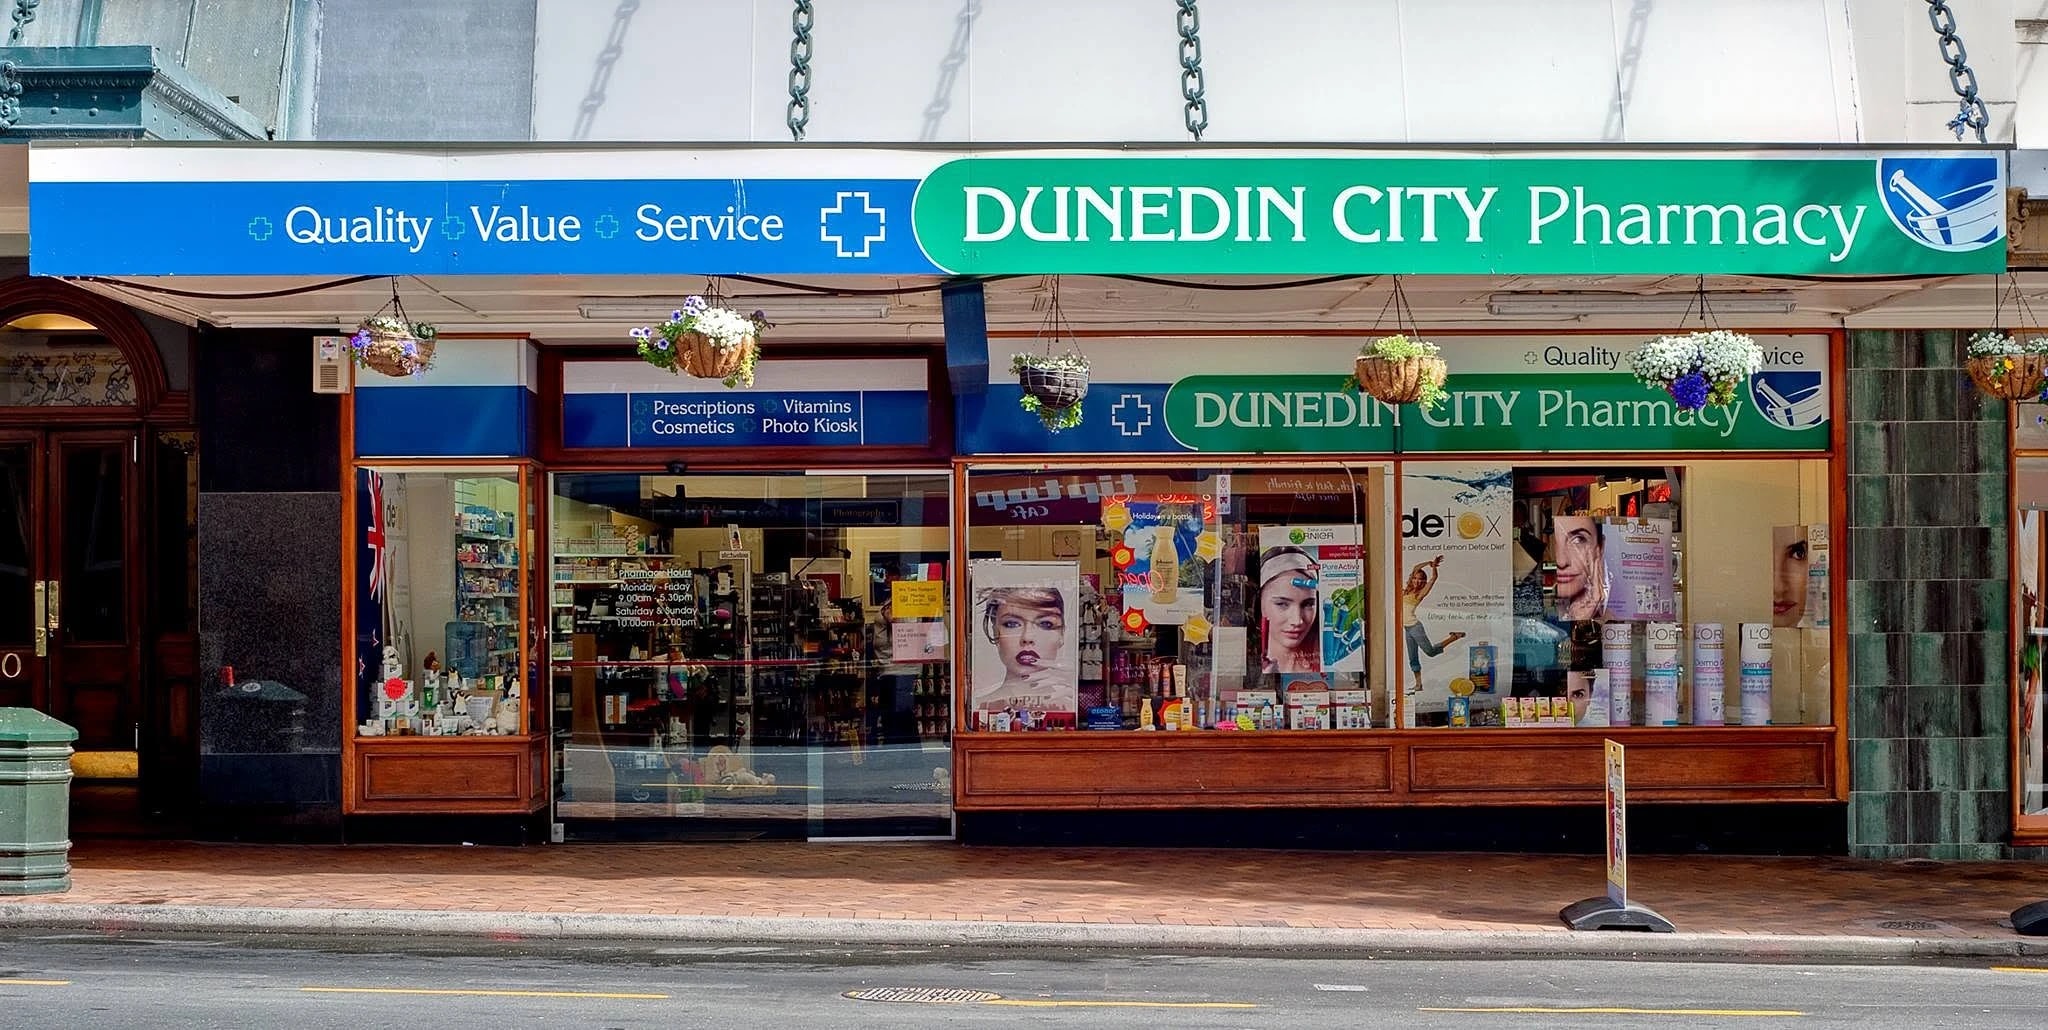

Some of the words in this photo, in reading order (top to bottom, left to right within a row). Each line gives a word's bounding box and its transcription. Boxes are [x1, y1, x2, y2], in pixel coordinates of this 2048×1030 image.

[285, 205, 434, 253] Quality
[470, 205, 582, 242] Value
[635, 203, 784, 242] Service
[963, 185, 1308, 242] DUNEDIN
[1331, 185, 1500, 244] CITY
[1527, 185, 1868, 263] Pharmacy
[1543, 345, 1622, 370] Quality
[653, 400, 755, 418] Prescriptions
[783, 399, 852, 415] Vitamins
[1194, 391, 1401, 428] DUNEDIN
[1419, 390, 1521, 428] CITY
[1537, 389, 1744, 437] Pharmacy
[652, 419, 735, 435] Cosmetics
[762, 418, 809, 434] Photo
[814, 417, 859, 434] Kiosk
[1132, 512, 1157, 522] Holiday
[1402, 507, 1502, 540] detox
[1417, 543, 1442, 551] natural
[1443, 543, 1468, 551] Lemon
[1468, 543, 1490, 551] Detox
[667, 568, 692, 578] Hours
[620, 582, 657, 592] Monday
[664, 582, 691, 592] Friday
[618, 594, 652, 603] 9.00am
[660, 593, 693, 602] 5.30pm
[615, 607, 654, 617] Saturday
[664, 606, 698, 616] Sunday
[617, 619, 655, 628] 10.00am
[663, 618, 697, 628] 2.00pm
